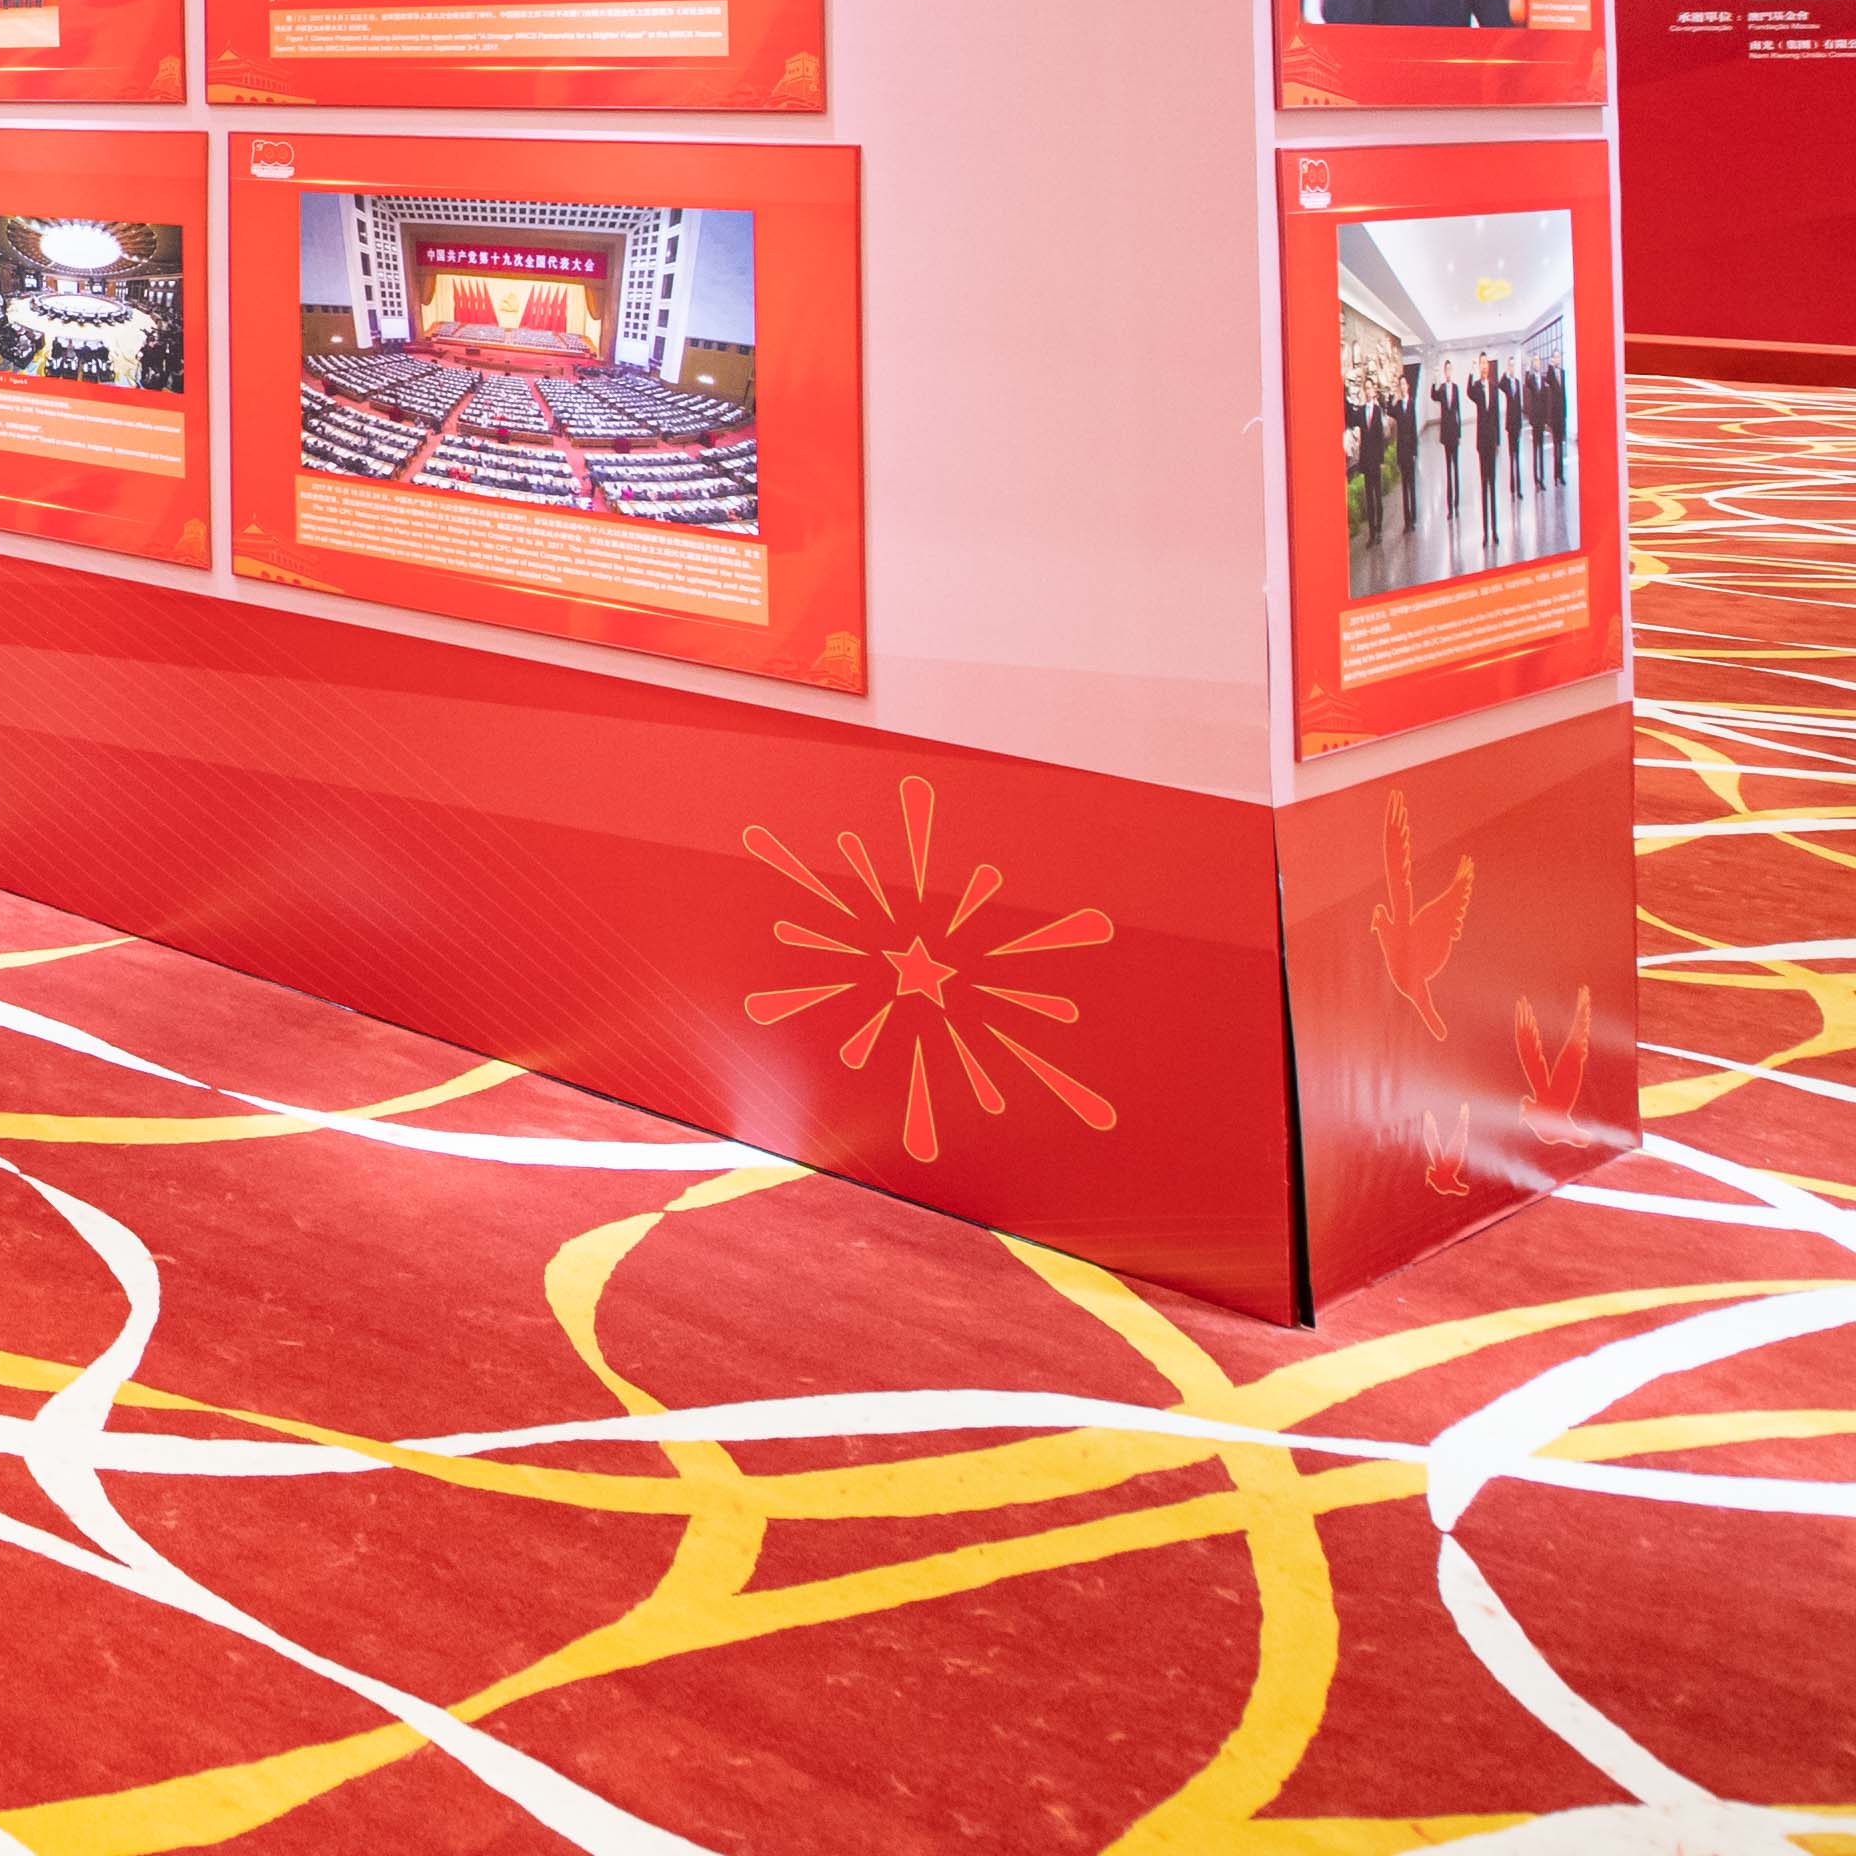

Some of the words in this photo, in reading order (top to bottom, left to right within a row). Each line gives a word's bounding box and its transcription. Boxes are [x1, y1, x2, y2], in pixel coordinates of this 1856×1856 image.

[426, 248, 596, 273] 中国共产党第十九次全国代表大会
